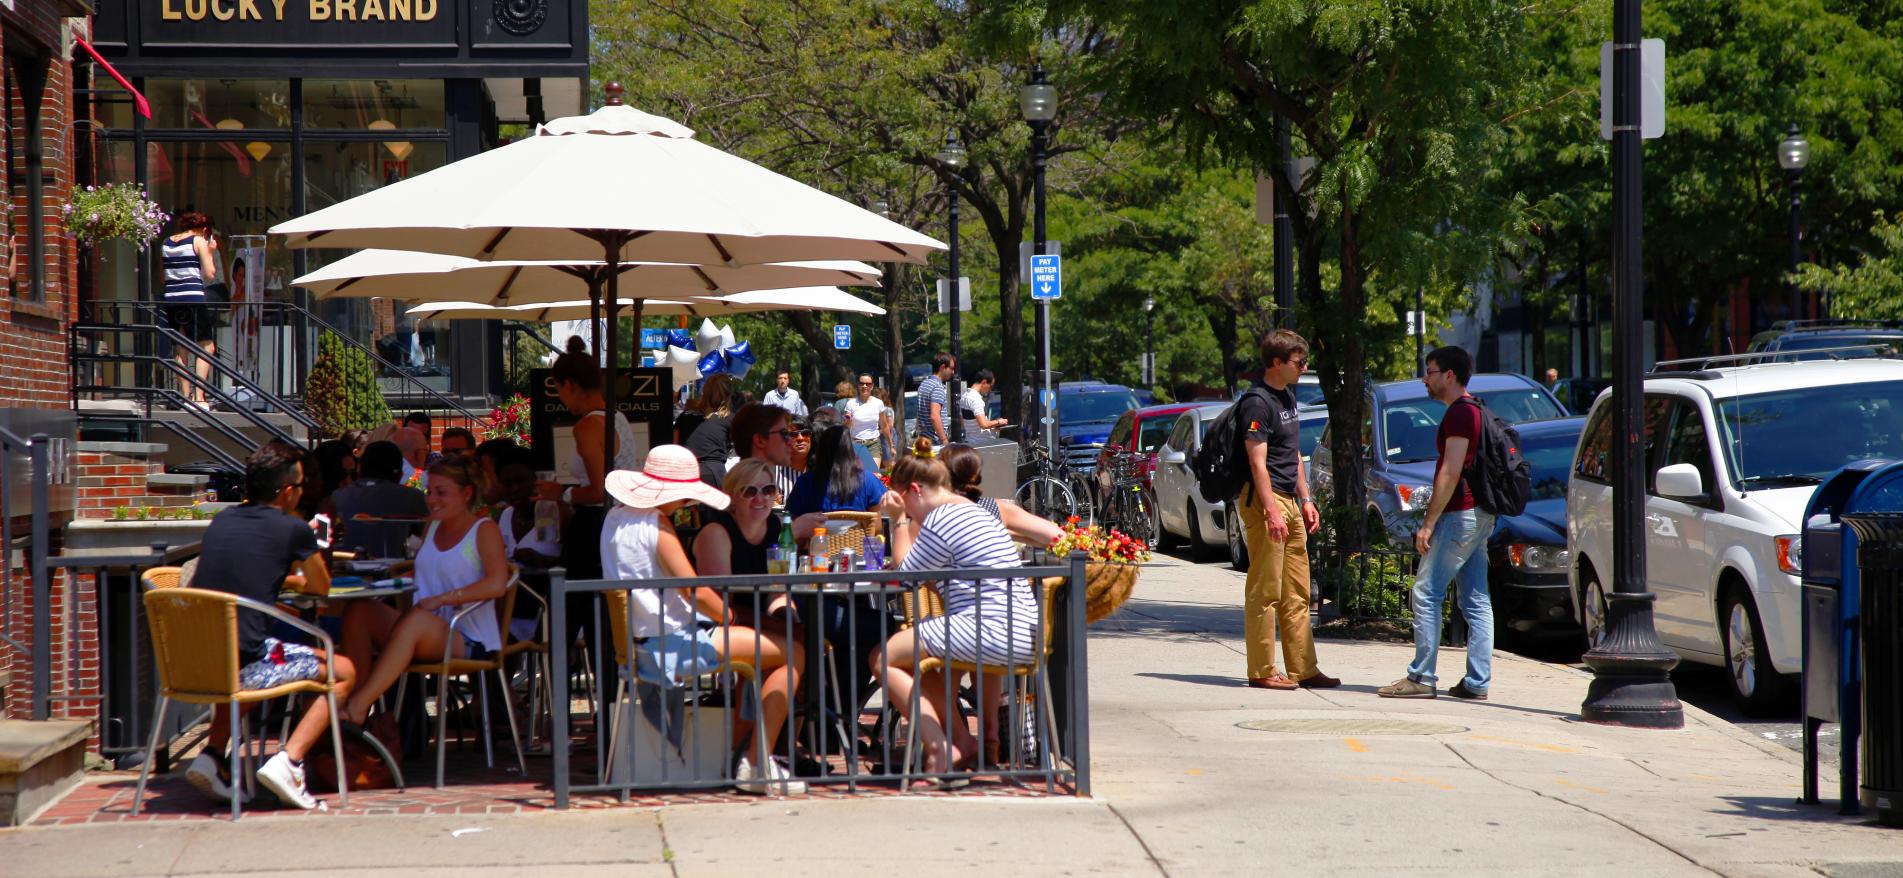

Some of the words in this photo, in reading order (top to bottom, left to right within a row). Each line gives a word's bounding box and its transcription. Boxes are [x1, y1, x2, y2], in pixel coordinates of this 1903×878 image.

[162, 0, 288, 20] LUCKY
[309, 0, 438, 20] BRAND
[383, 160, 409, 177] EXIT
[544, 375, 660, 397] SZI
